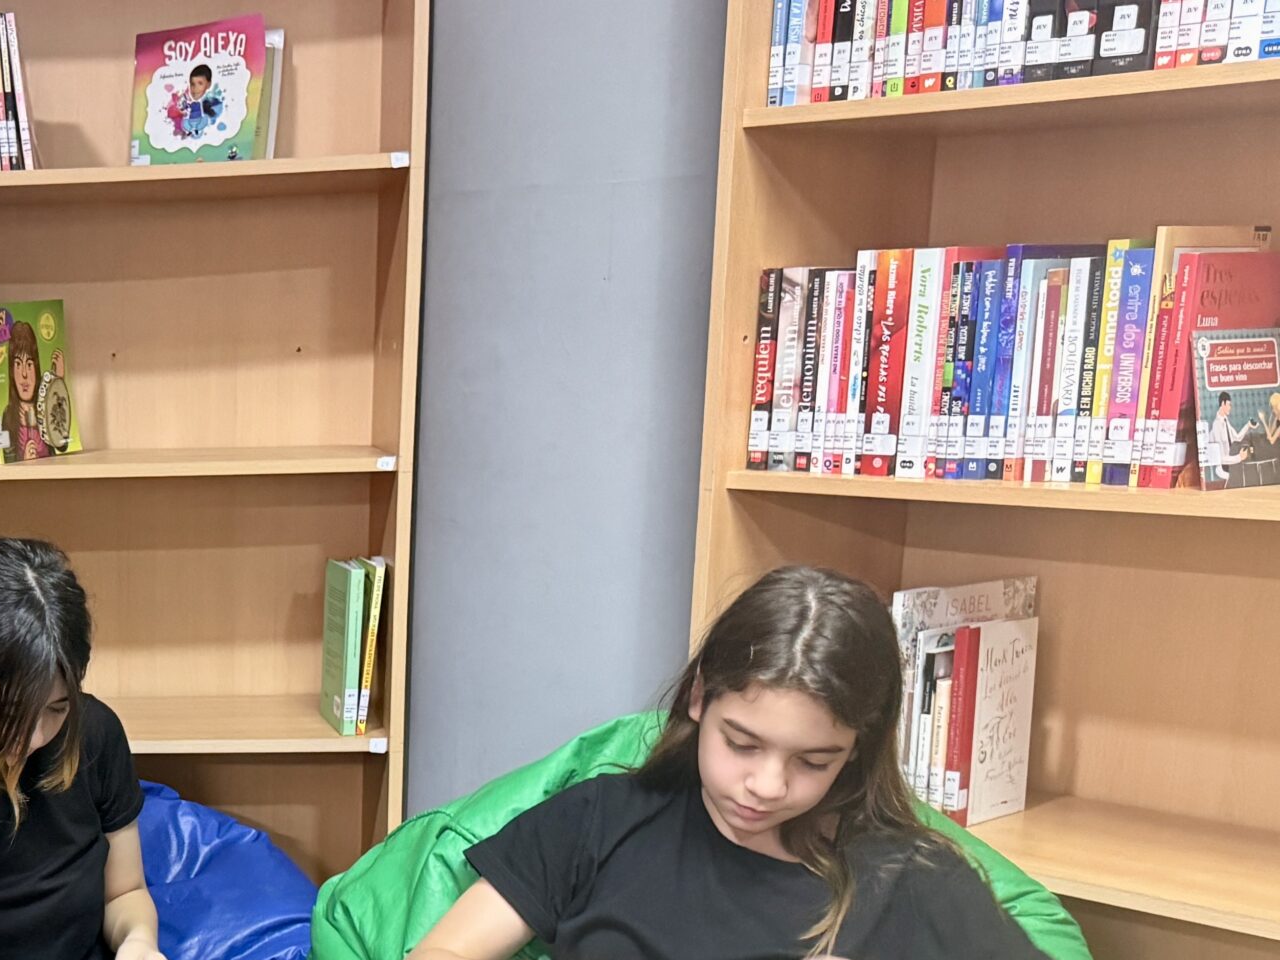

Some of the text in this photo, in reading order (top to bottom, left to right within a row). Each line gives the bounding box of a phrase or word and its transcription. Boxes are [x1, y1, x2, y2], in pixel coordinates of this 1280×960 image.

[163, 31, 246, 65] SOY ALEXA
[1204, 264, 1232, 283] Tres
[913, 265, 932, 364] Nora Roberts
[1197, 314, 1218, 327] Luna
[1103, 310, 1119, 356] anna
[1123, 324, 1140, 348] dos
[754, 326, 771, 403] requiem
[775, 326, 798, 414] elirium
[1084, 347, 1096, 369] RARO
[1229, 364, 1241, 373] para
[1243, 360, 1272, 370] descorchar
[1062, 336, 1078, 406] BOULEVARD
[1082, 371, 1093, 395] BICHO
[1115, 353, 1135, 404] UNIVERSOS
[1220, 373, 1234, 382] buen
[1235, 372, 1247, 381] vino
[1081, 398, 1091, 408] EN
[945, 594, 992, 617] ISABEL
